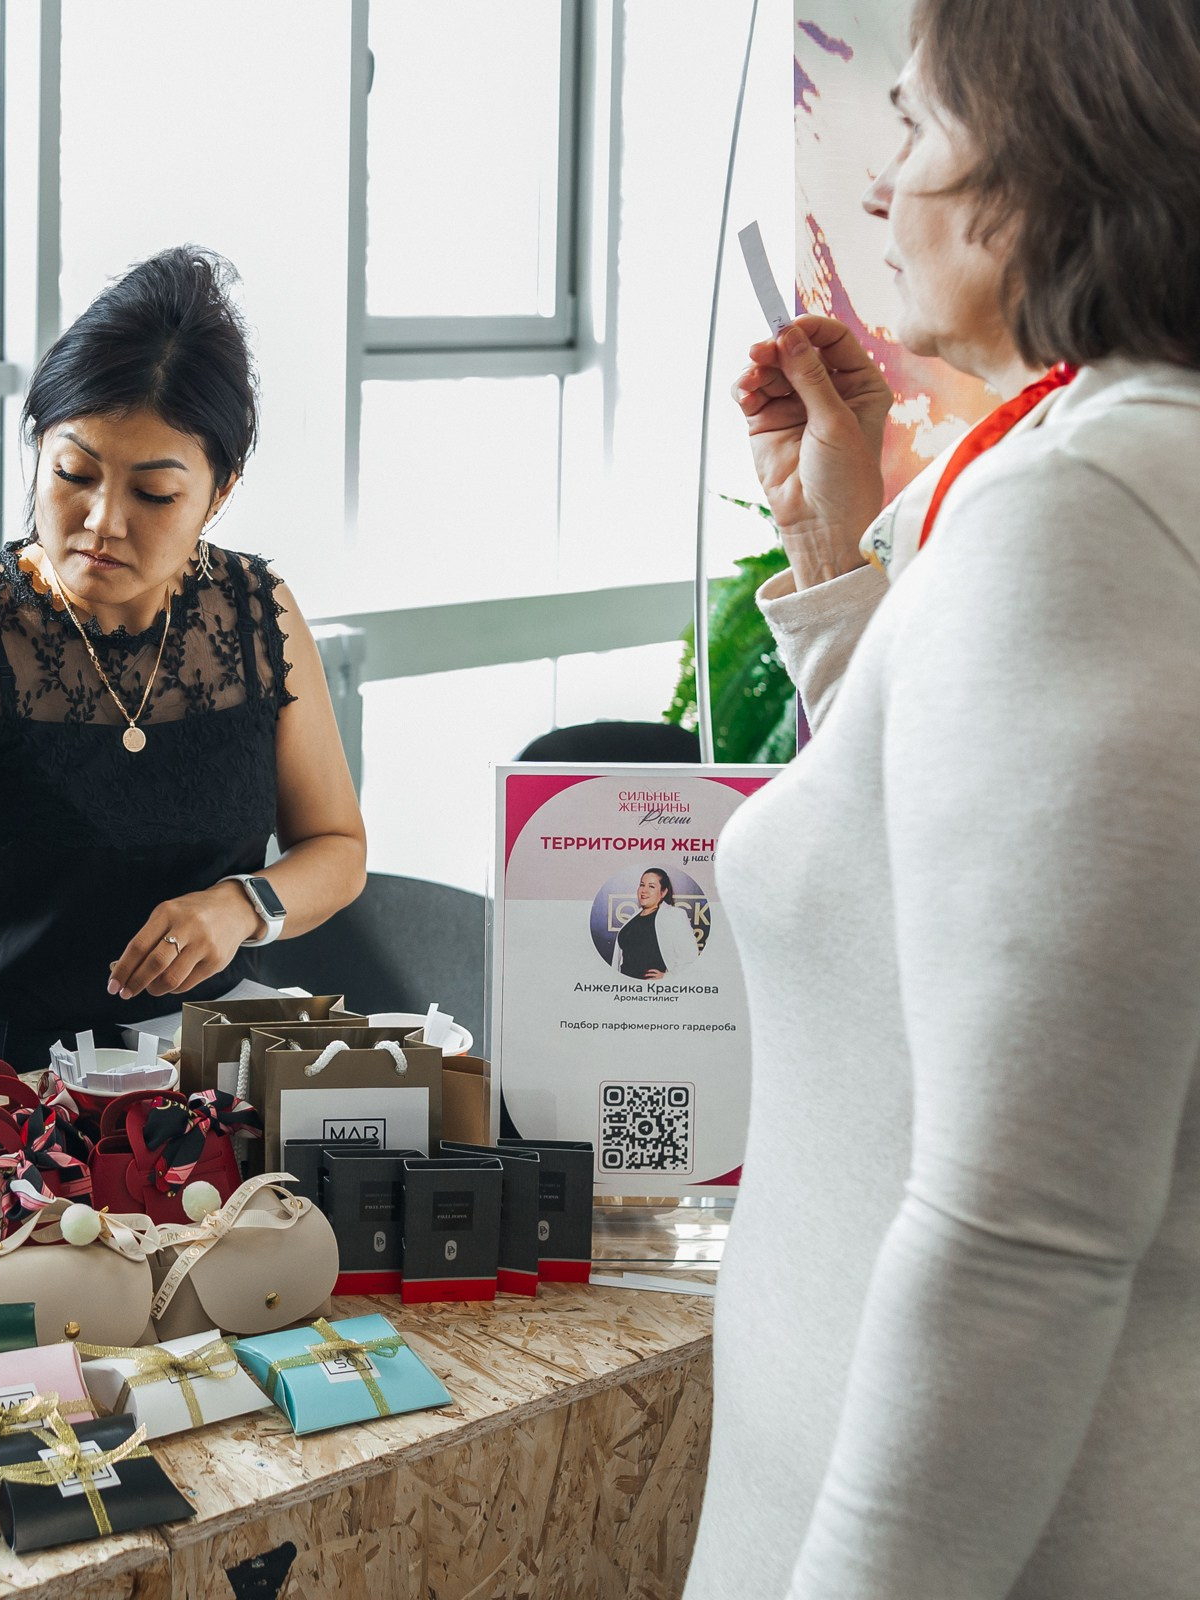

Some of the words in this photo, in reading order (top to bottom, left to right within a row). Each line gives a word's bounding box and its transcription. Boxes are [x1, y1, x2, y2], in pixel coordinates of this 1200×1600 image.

[618, 791, 681, 801] СИЛЬНЫЕ
[618, 802, 690, 813] ЖЕНЩИНЫ
[638, 809, 691, 826] России
[540, 836, 665, 851] ТЕРРИТОРИЯ
[671, 838, 718, 851] ЖЕН
[574, 982, 642, 993] Анжелика
[647, 983, 719, 994] Красикова
[613, 994, 679, 1002] Аромастилист
[560, 1020, 599, 1030] Подбор
[601, 1022, 680, 1032] парфюмерного
[682, 1023, 737, 1032] гардероба
[330, 1126, 380, 1140] MAR
